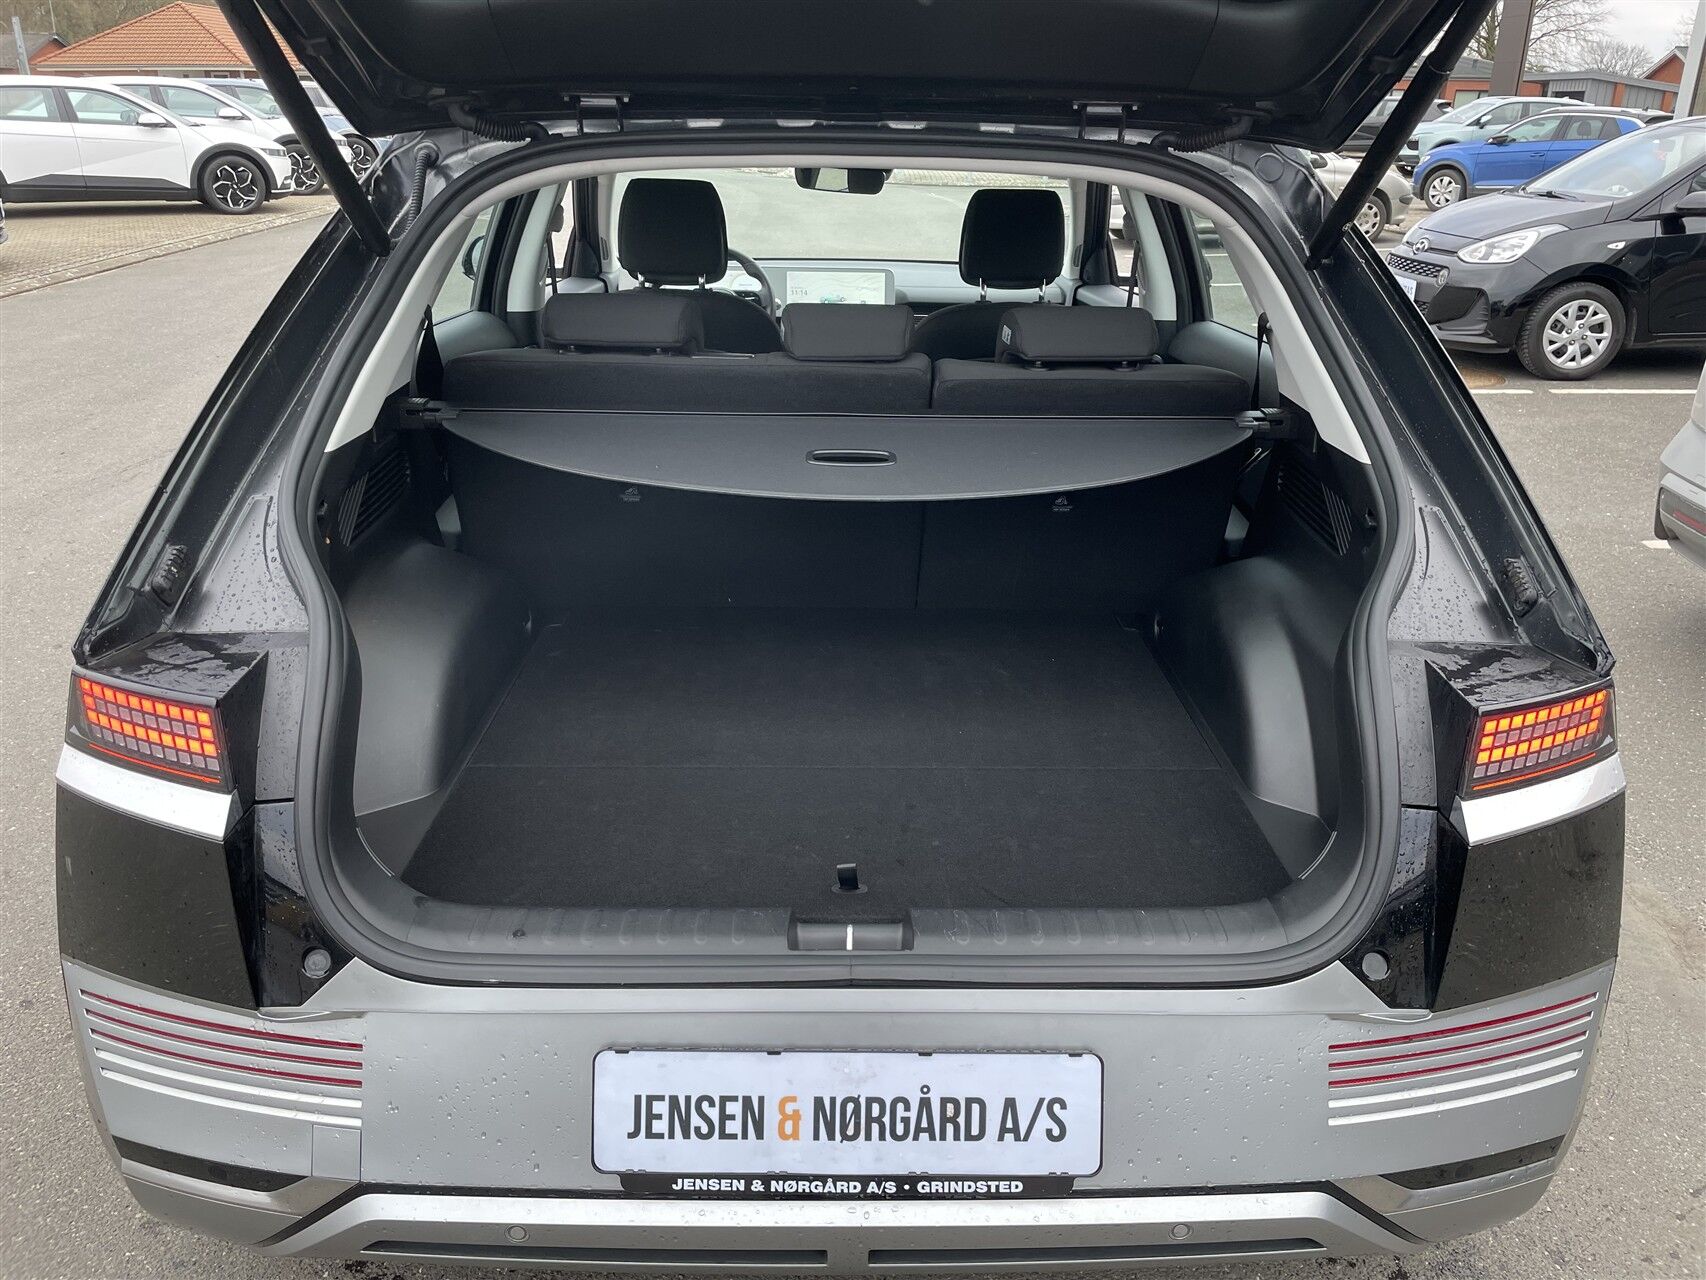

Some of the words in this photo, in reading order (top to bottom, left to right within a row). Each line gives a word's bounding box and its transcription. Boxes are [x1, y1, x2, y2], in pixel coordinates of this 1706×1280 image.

[626, 1094, 765, 1141] JENSEN
[777, 1095, 802, 1141] &
[812, 1084, 987, 1144] NØRGÅRD
[997, 1096, 1068, 1143] A/S
[671, 1178, 746, 1192] JENSEN
[750, 1179, 766, 1192] &
[770, 1177, 862, 1194] NØRGÅRD
[866, 1181, 897, 1195] A/S
[916, 1180, 1024, 1194] GRINDSTED
